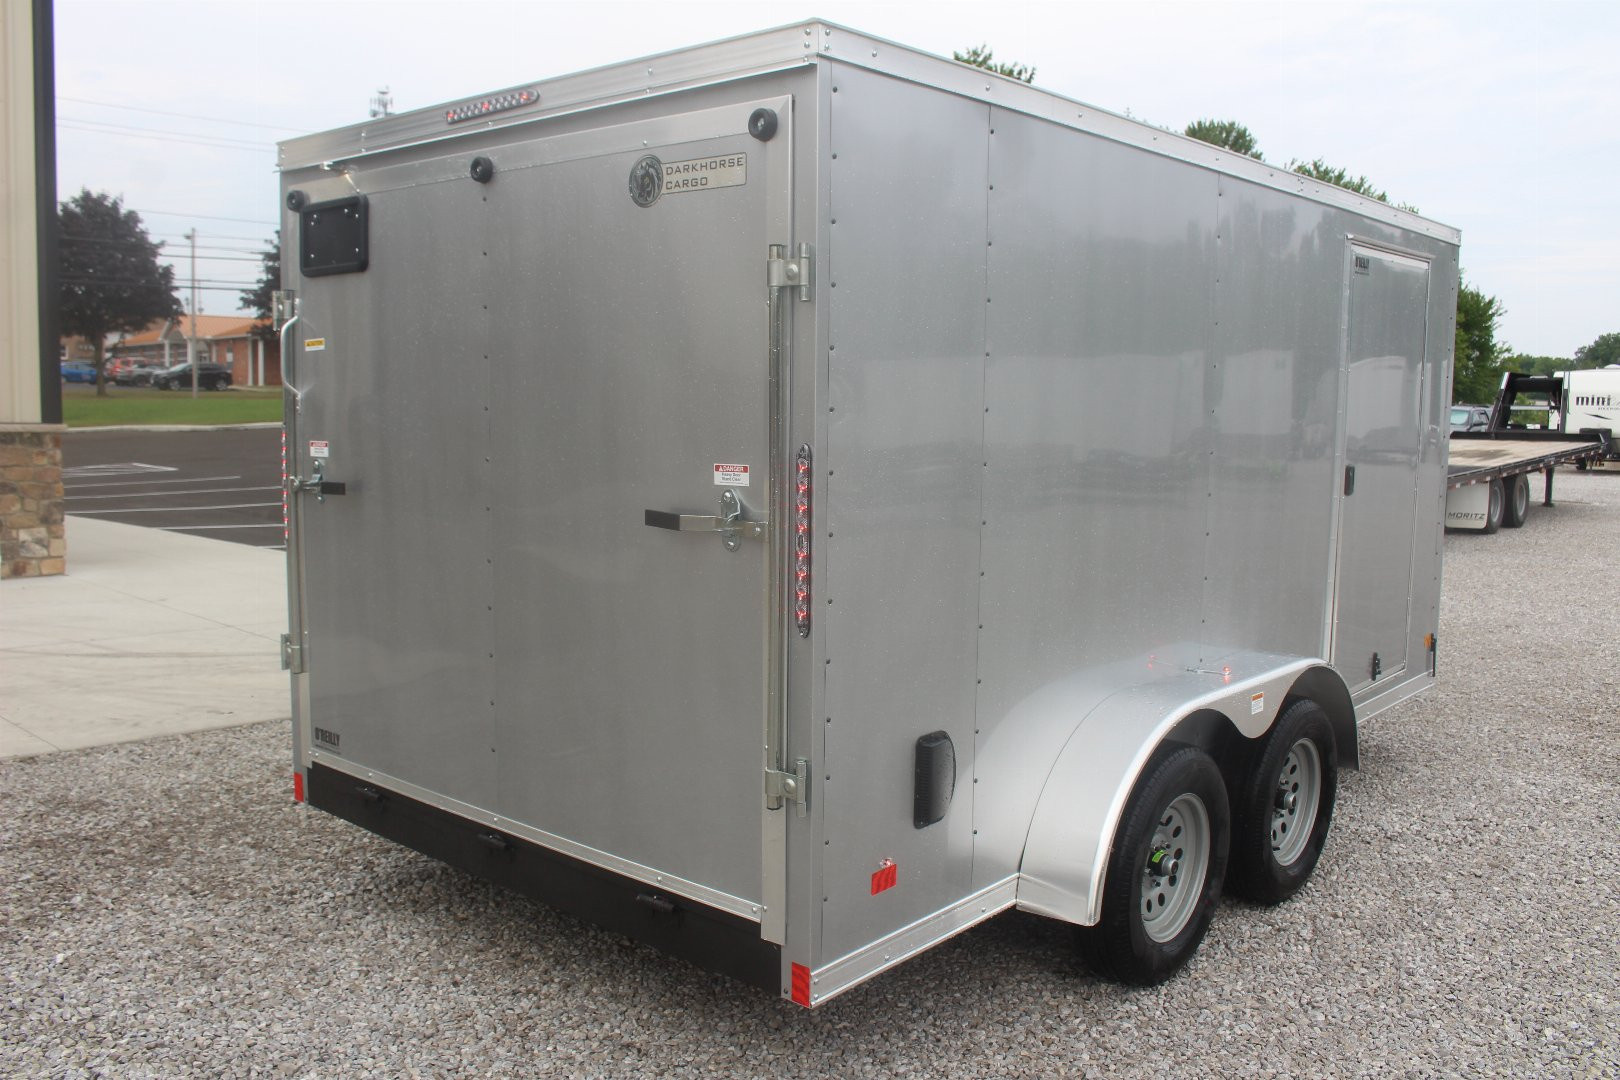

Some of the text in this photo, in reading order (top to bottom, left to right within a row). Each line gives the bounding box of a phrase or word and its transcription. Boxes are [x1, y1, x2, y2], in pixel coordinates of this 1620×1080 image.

[665, 157, 744, 176] DARKHORSE
[665, 176, 708, 190] CARGO
[1576, 394, 1612, 406] mini
[1448, 511, 1486, 520] MORITZ
[314, 726, 341, 747] O'REILLY
